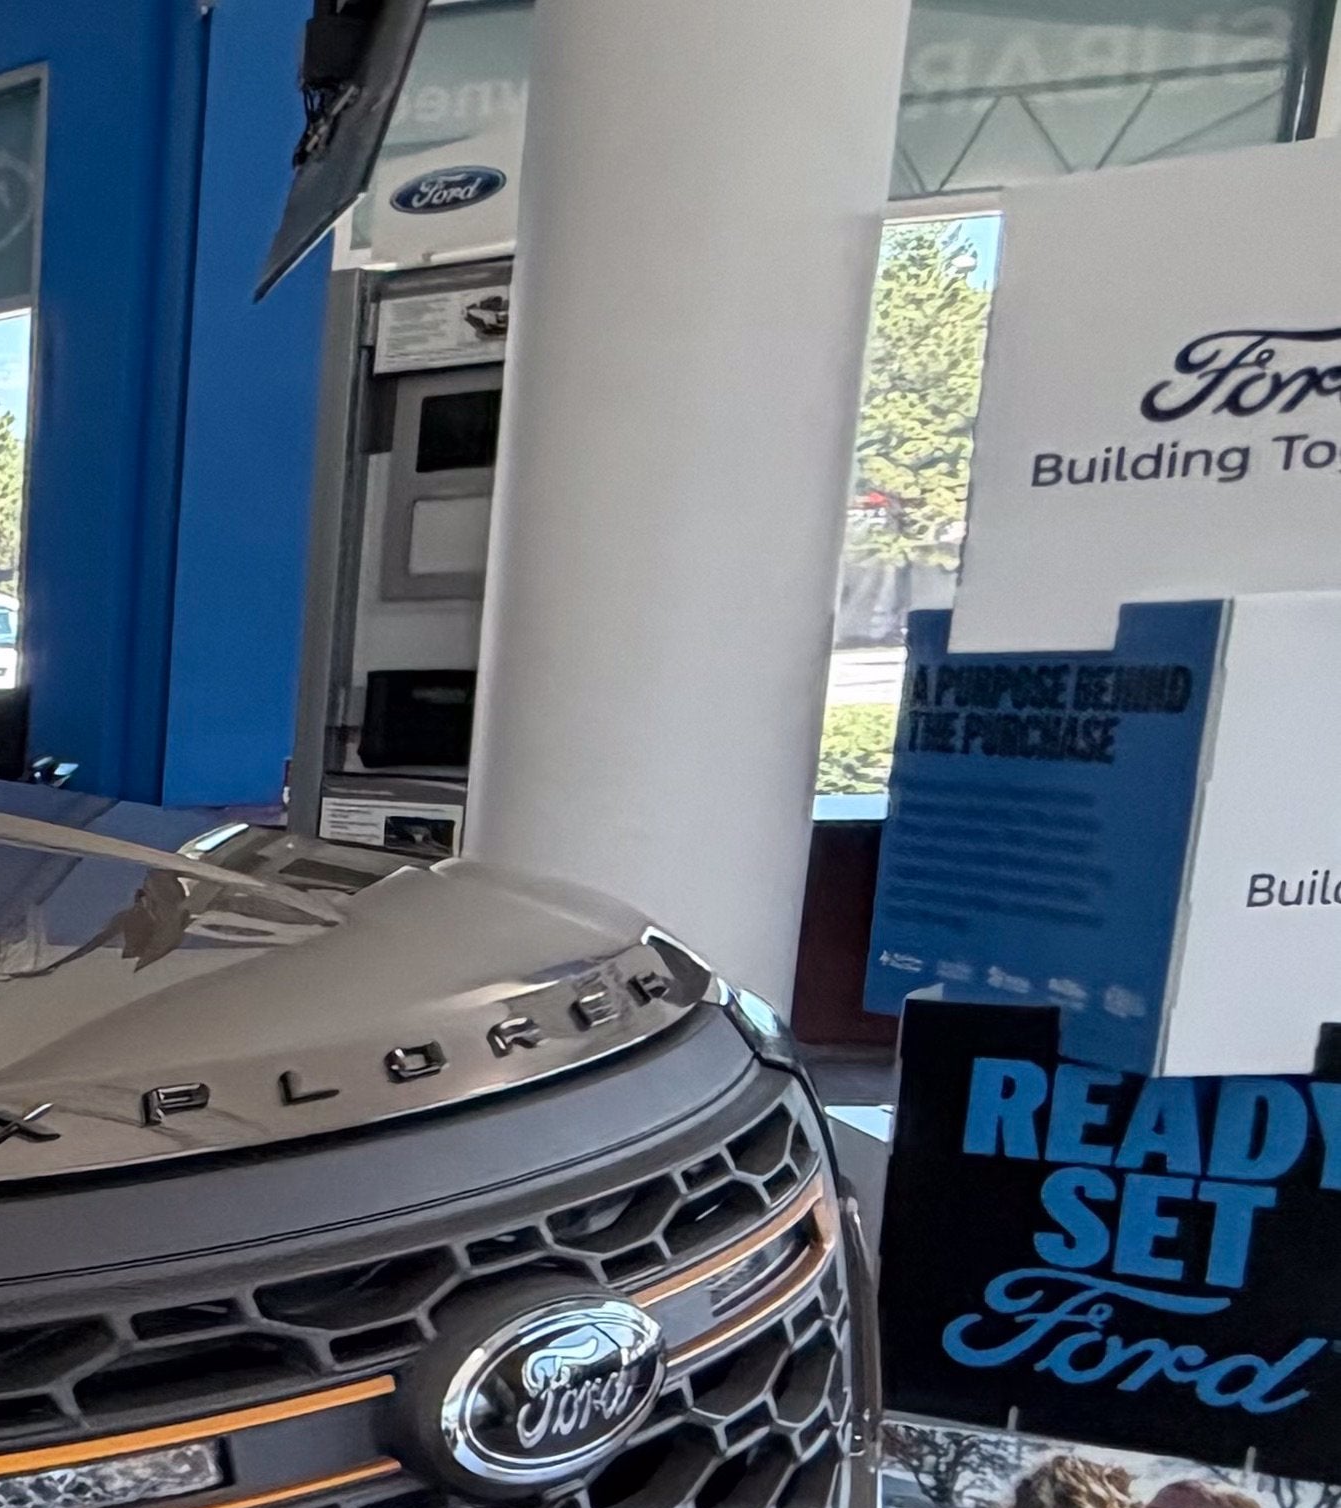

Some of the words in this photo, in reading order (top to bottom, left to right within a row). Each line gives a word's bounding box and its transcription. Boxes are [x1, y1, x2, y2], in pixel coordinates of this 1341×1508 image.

[411, 172, 483, 208] Ford
[1140, 328, 1341, 423] For
[1030, 440, 1251, 488] Building
[1271, 434, 1341, 473] To
[936, 664, 1070, 709] PURPOSE
[908, 710, 962, 754] THE
[963, 713, 1122, 765] PURCHASE
[1033, 1166, 1278, 1289] SET
[941, 1267, 1328, 1415] Ford
[516, 1334, 643, 1450] Ford
